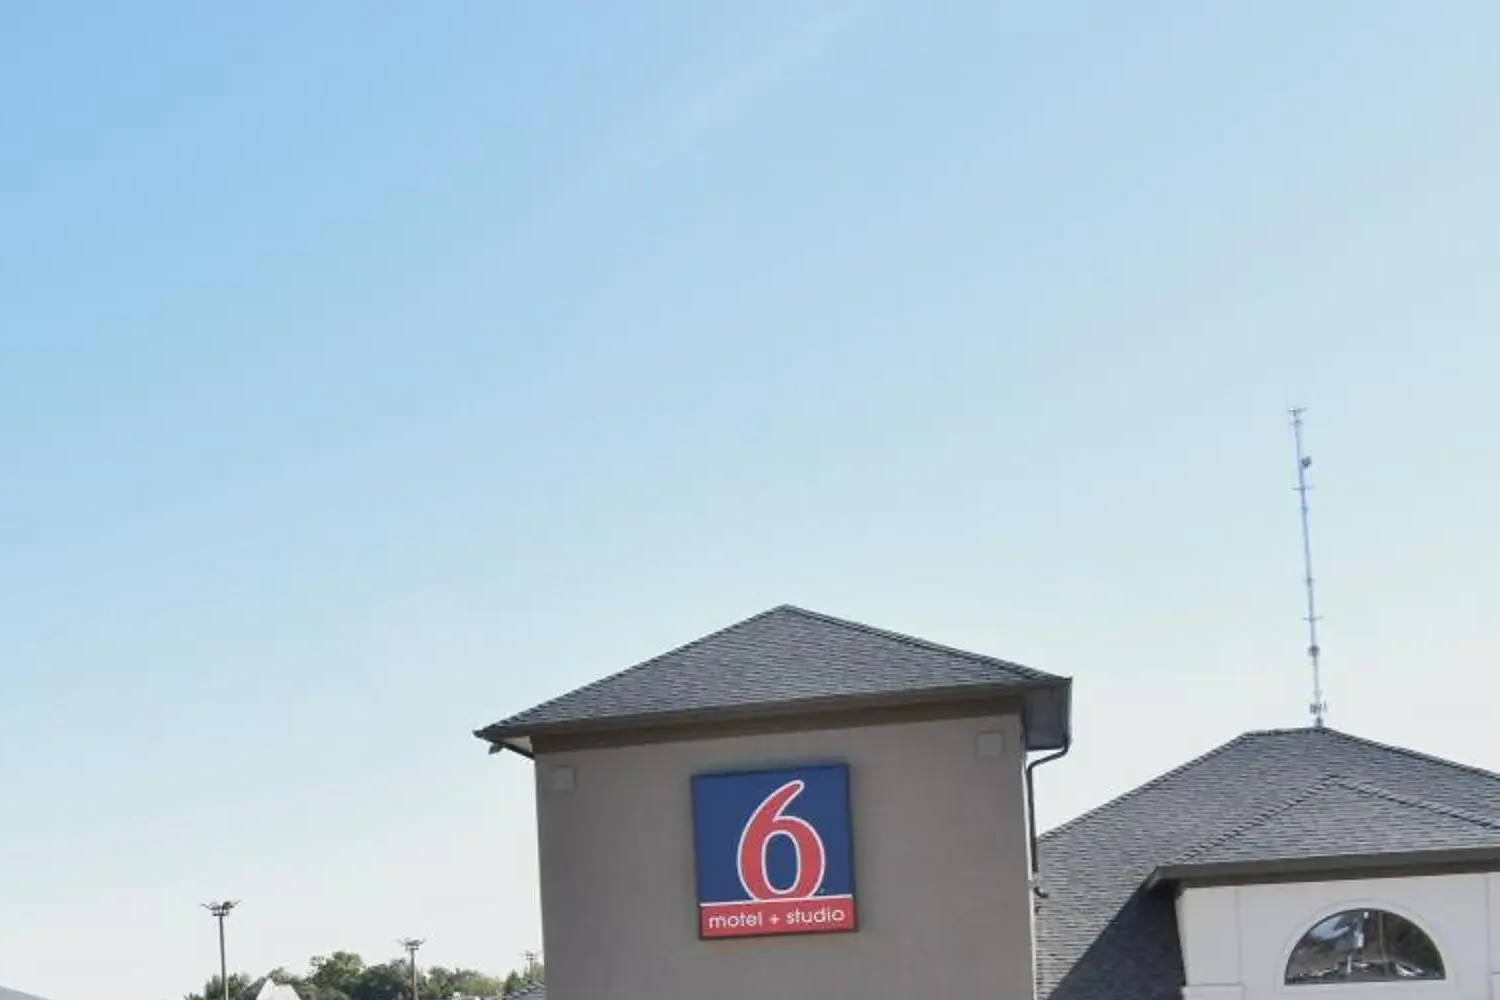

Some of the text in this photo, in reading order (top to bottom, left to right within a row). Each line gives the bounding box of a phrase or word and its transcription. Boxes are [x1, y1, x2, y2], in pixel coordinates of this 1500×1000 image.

[737, 779, 826, 901] 6
[708, 911, 763, 929] motel
[786, 906, 846, 925] studio
